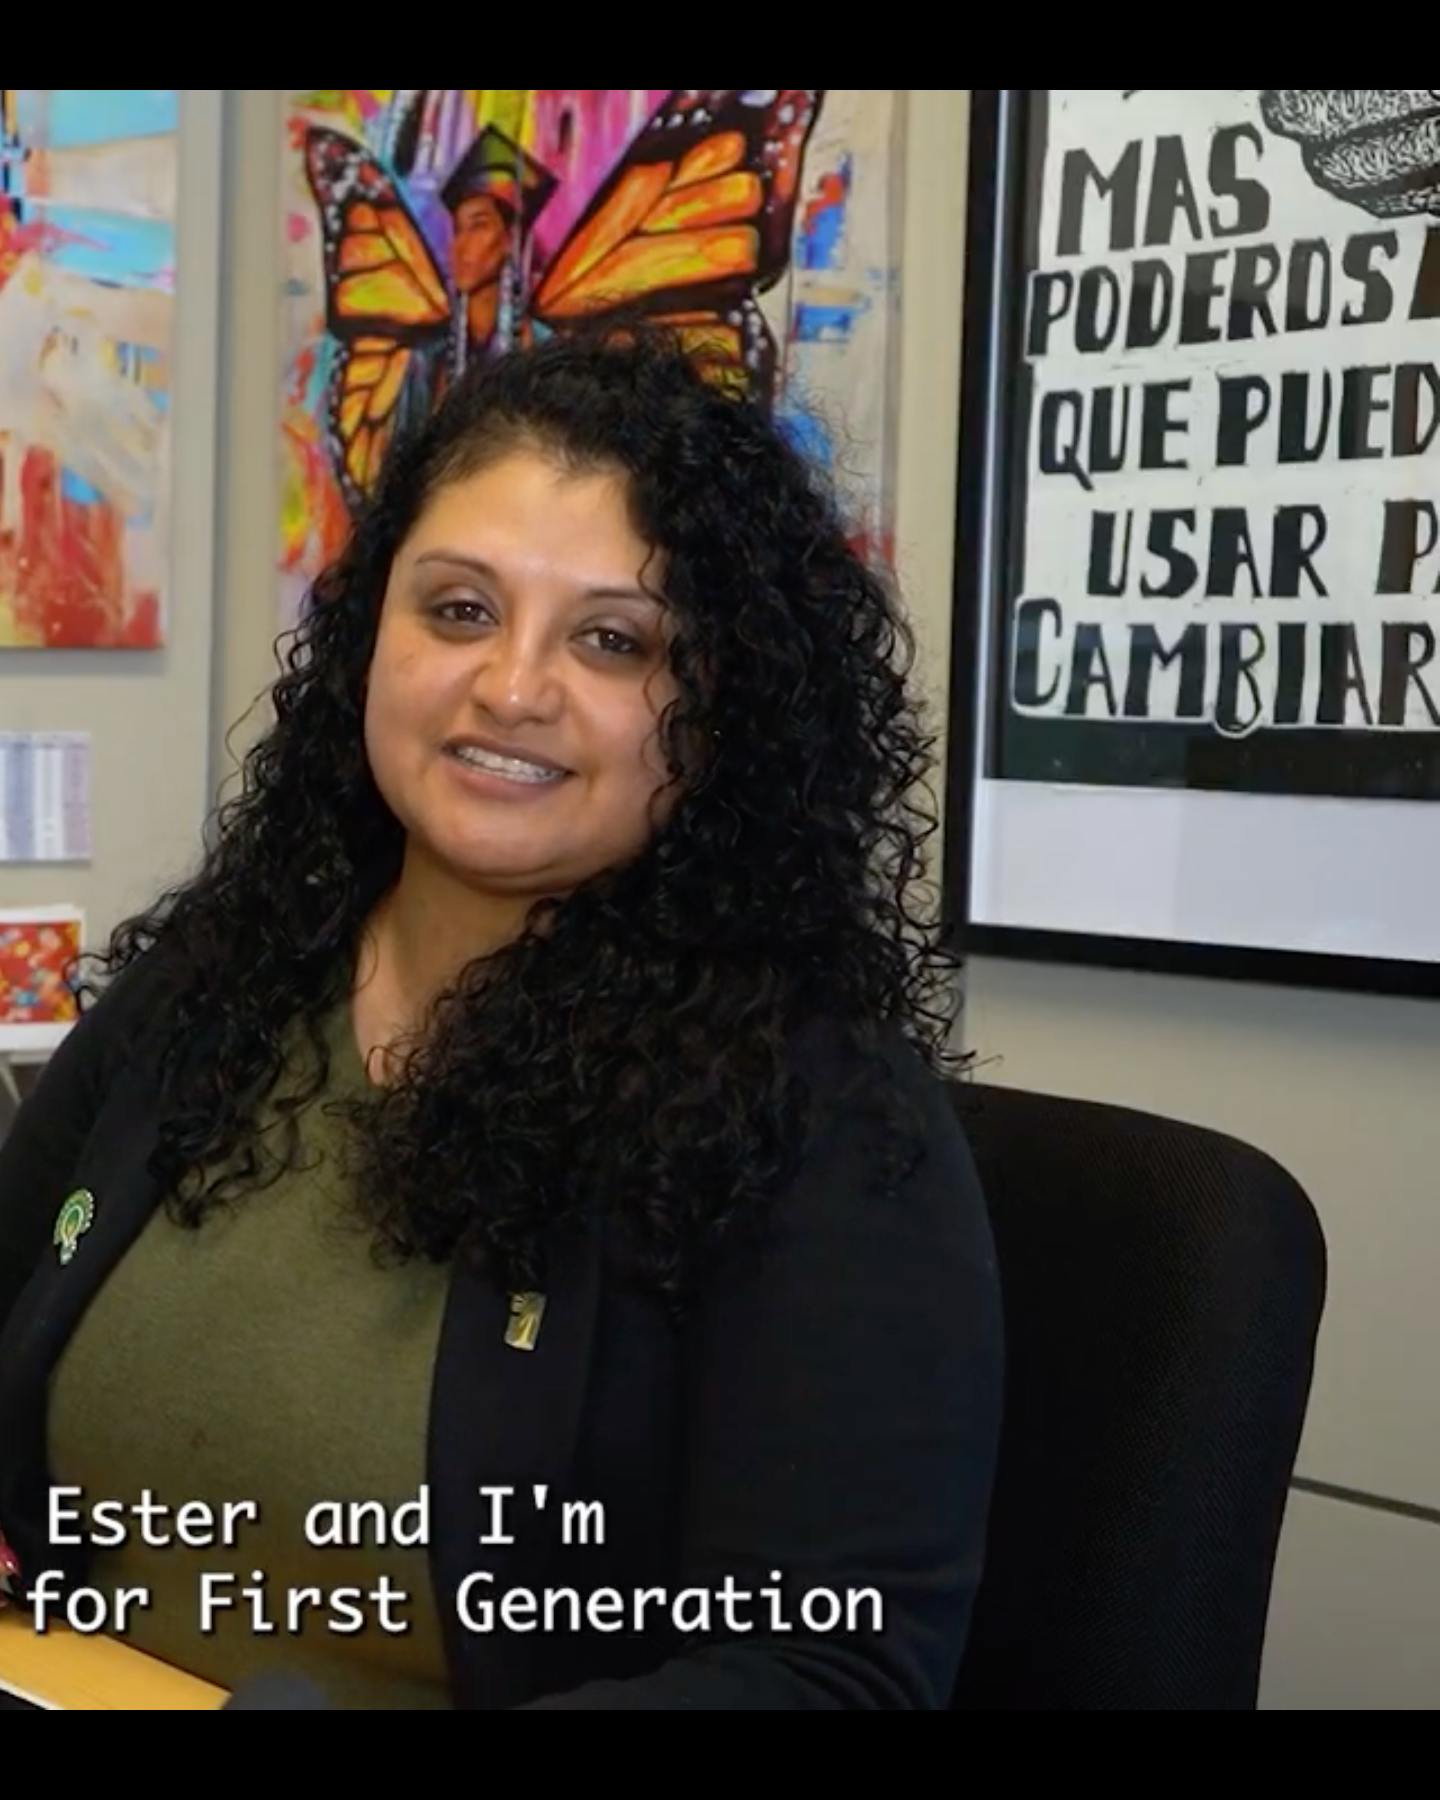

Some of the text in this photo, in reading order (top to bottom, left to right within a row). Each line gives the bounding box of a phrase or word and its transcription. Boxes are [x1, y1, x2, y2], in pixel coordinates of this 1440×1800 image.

[1055, 121, 1271, 257] MAS
[1039, 362, 1440, 491] QUE PUED
[1086, 498, 1440, 599] USAR P
[1013, 598, 1440, 730] CAMBIAR
